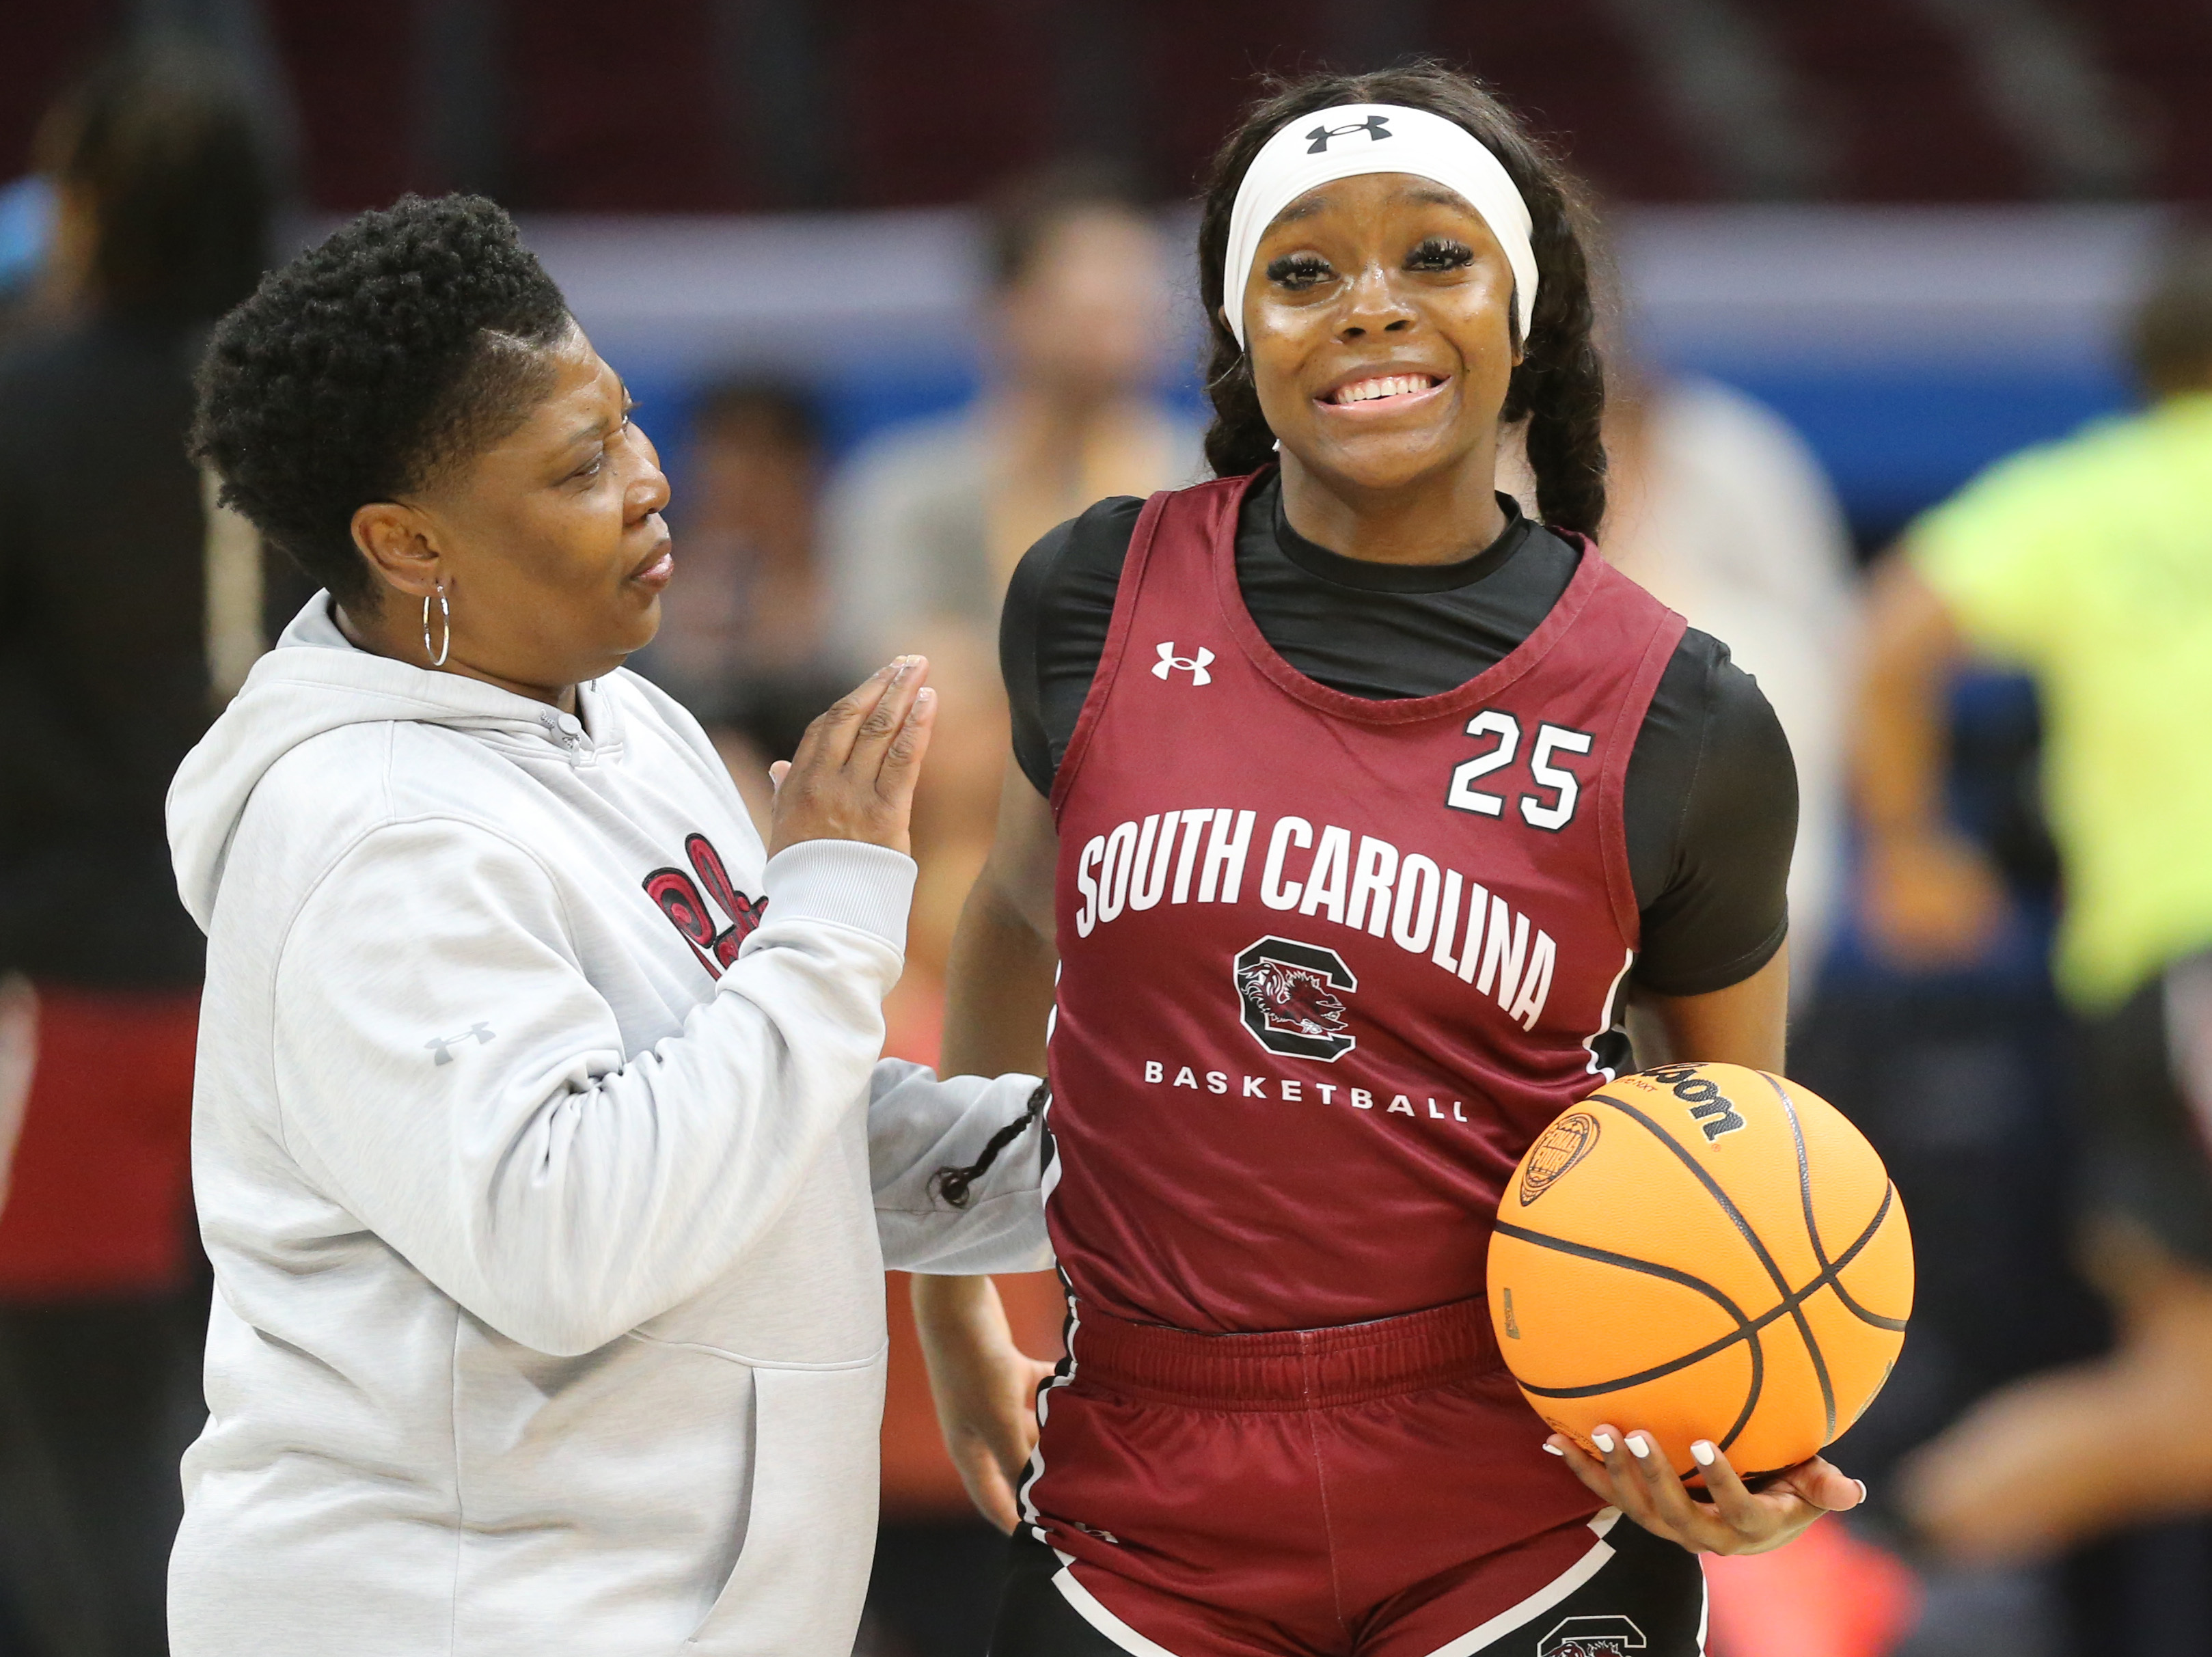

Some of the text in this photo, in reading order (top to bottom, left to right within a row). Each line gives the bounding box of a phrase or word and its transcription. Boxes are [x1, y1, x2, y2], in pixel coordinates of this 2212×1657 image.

[1444, 707, 1596, 834] 25
[1076, 808, 1557, 1032] SOUTH CAROLINA
[1144, 1060, 1469, 1123] BASKETBALL
[1632, 1080, 1658, 1092] NXT
[1531, 1147, 1571, 1173] FOUR
[1540, 1129, 1582, 1153] FINAL
